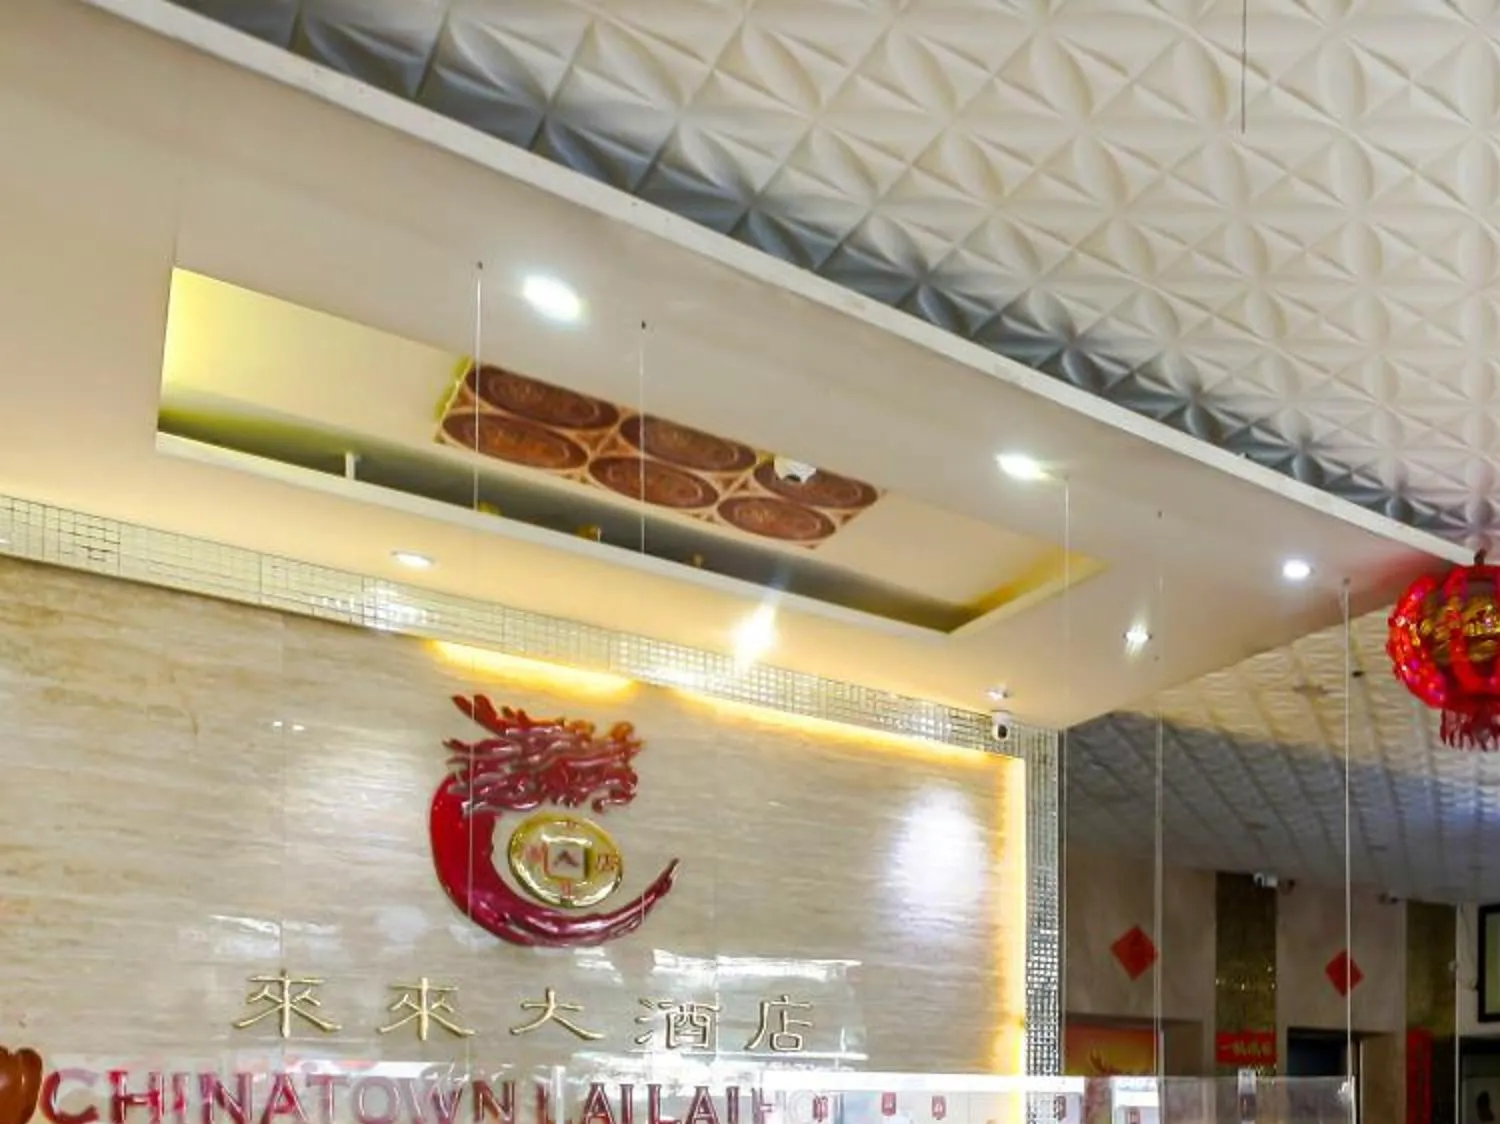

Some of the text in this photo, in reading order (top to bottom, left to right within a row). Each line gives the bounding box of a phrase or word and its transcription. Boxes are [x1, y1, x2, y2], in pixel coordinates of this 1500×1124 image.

[231, 968, 815, 1053] 來來大酒店
